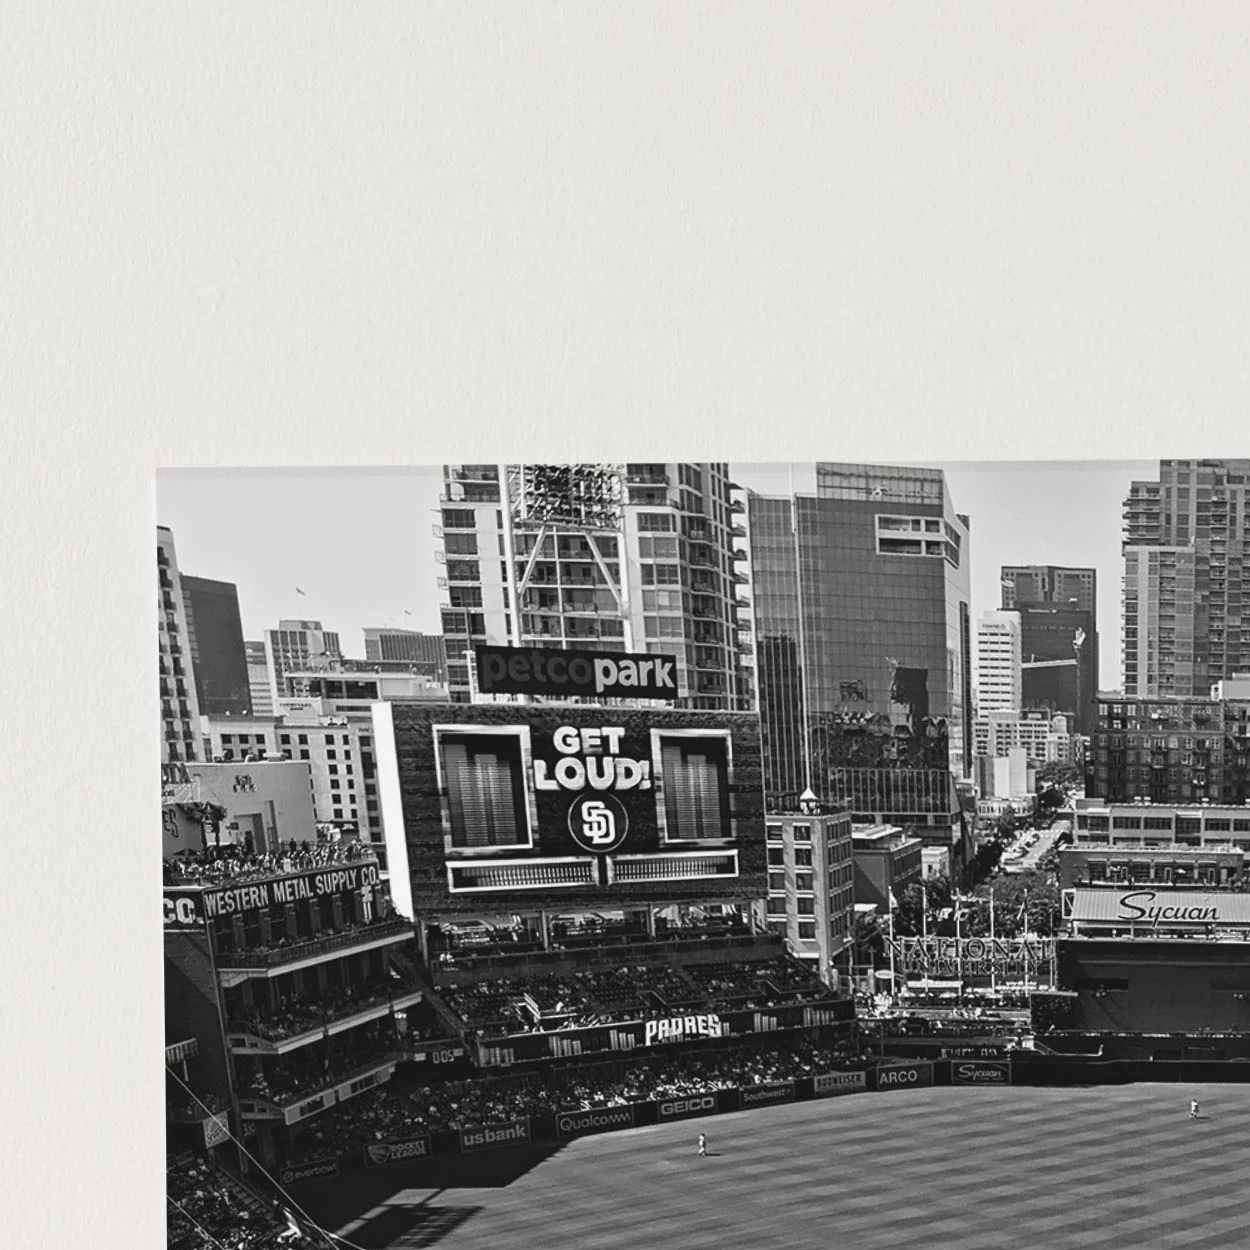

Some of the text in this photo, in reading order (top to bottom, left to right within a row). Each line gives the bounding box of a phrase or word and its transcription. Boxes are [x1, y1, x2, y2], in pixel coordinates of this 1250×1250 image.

[553, 725, 626, 755] GET
[533, 756, 652, 791] LOUD!
[580, 800, 617, 844] SD
[204, 866, 380, 917] WESTERN METAL SUPPLY CO.
[1118, 891, 1220, 929] Sycuan
[882, 935, 1056, 960] NATIONAL
[901, 957, 1040, 976] UNIVERSITY
[645, 1013, 722, 1046] PADRES
[879, 1069, 918, 1085] ARCO
[958, 1064, 1001, 1081] Sycuan
[660, 1097, 715, 1116] GEICO
